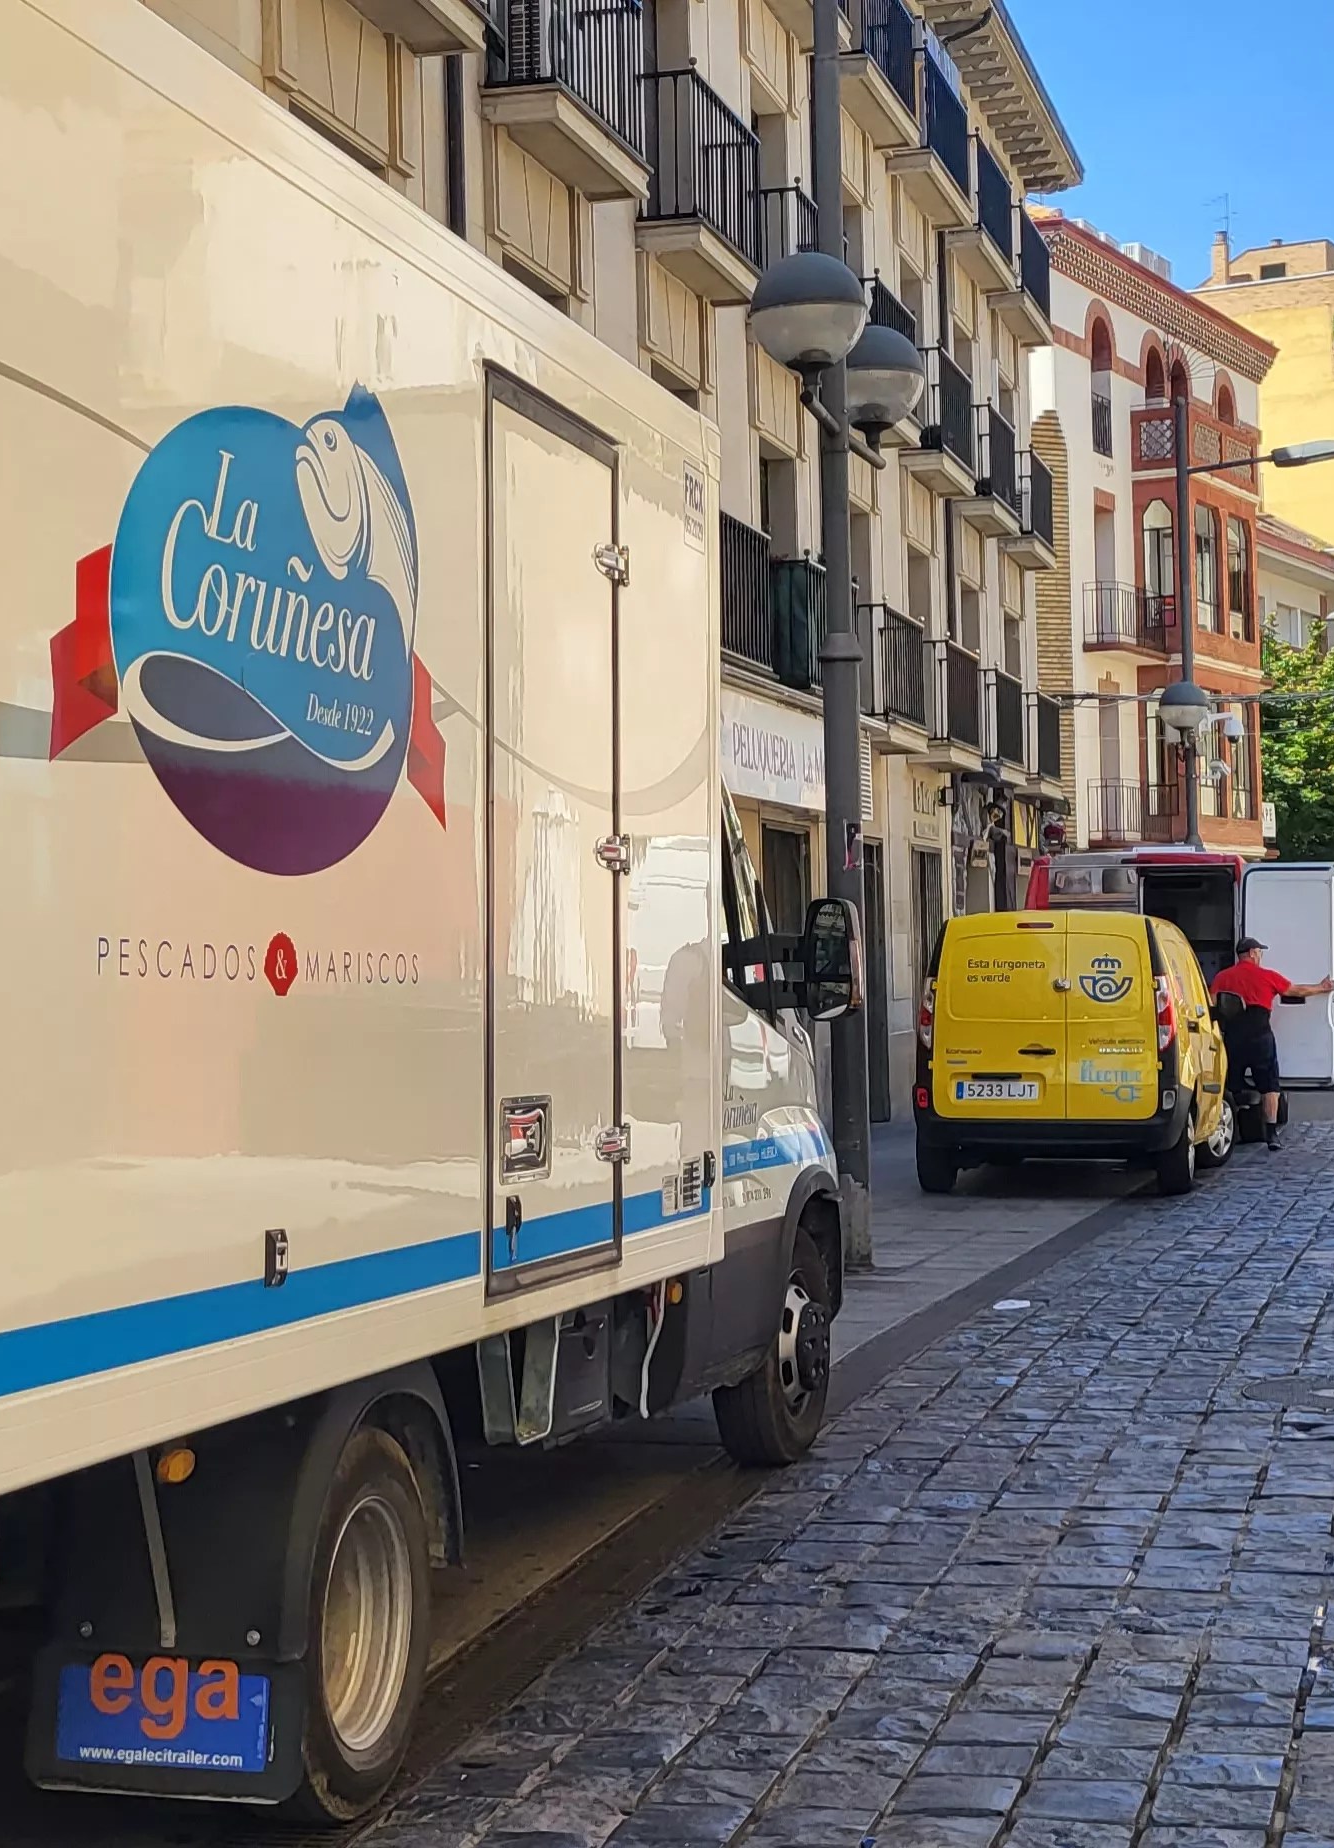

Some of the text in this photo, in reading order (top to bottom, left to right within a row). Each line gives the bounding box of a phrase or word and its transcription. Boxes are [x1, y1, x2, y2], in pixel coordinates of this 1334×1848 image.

[203, 450, 259, 553] La
[163, 499, 375, 682] Coruñesa
[307, 692, 374, 736] Desde 1922
[814, 745, 826, 786] M
[97, 935, 257, 982] PESCADOS
[305, 950, 420, 985] MARISCOS
[967, 957, 1046, 971] Esta furgoneta
[981, 972, 1011, 983] verde
[967, 1083, 1036, 1098] 5233 LJT
[723, 1094, 758, 1130] oruñesa
[90, 1652, 240, 1740] ega
[79, 1745, 243, 1768] www.egalecitrailer.com
